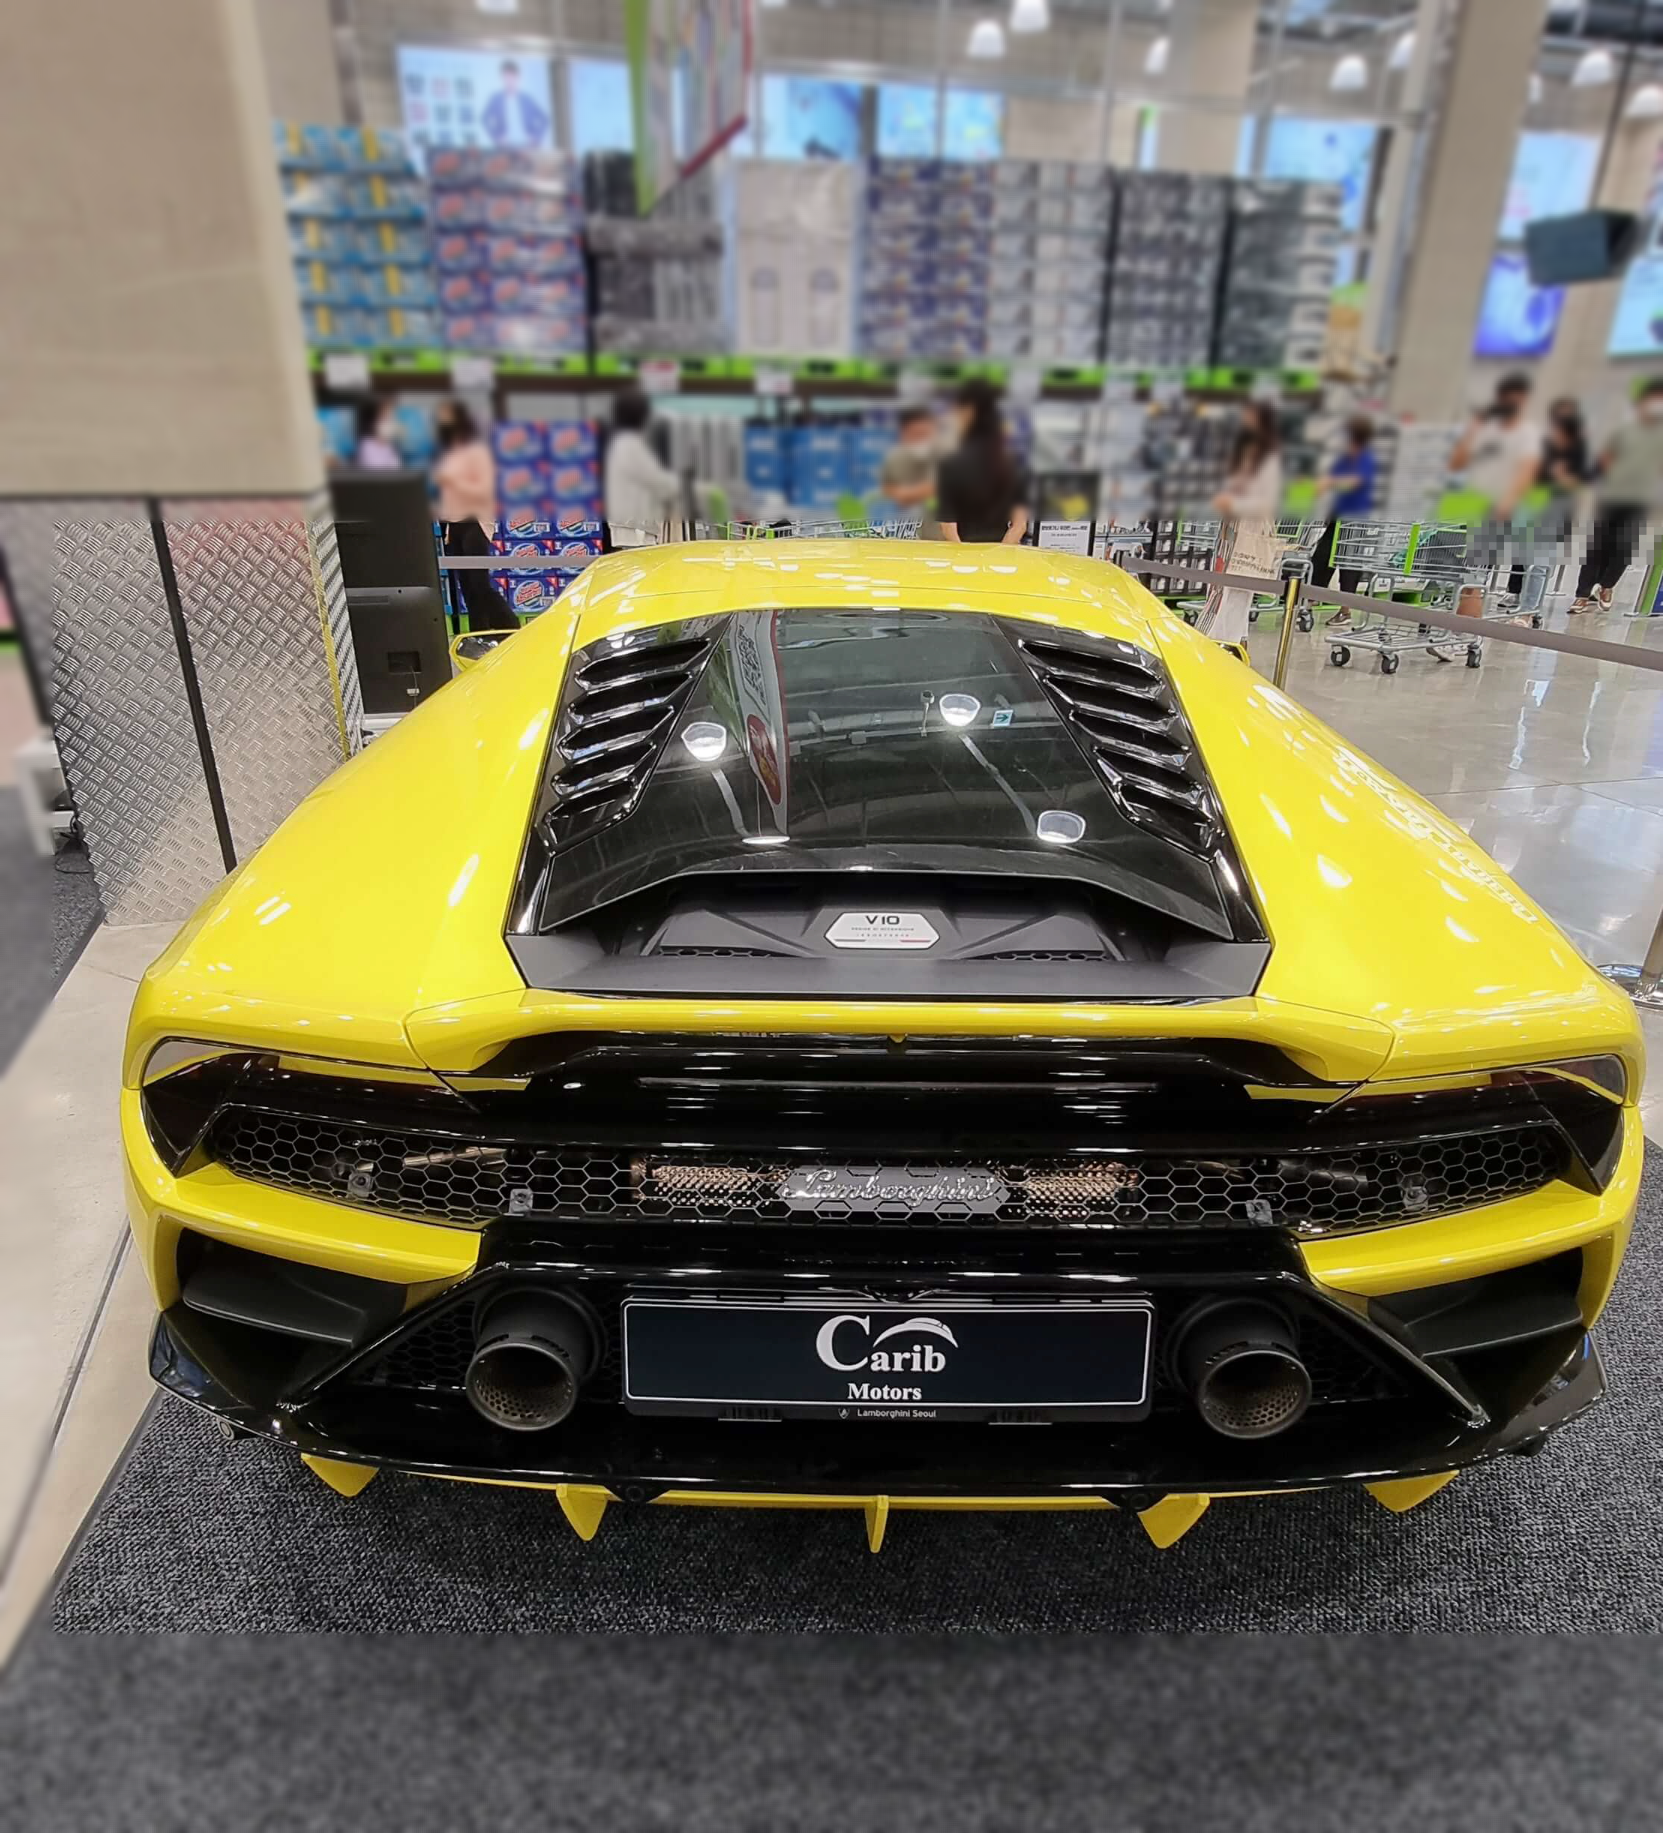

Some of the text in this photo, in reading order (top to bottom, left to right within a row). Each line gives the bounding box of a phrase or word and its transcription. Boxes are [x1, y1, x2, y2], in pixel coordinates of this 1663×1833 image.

[865, 915, 900, 925] V10
[781, 1168, 996, 1208] Lamborghini
[815, 1314, 947, 1372] Carib
[847, 1382, 922, 1401] Motors
[857, 1408, 937, 1419] Lamborghini Seoul
